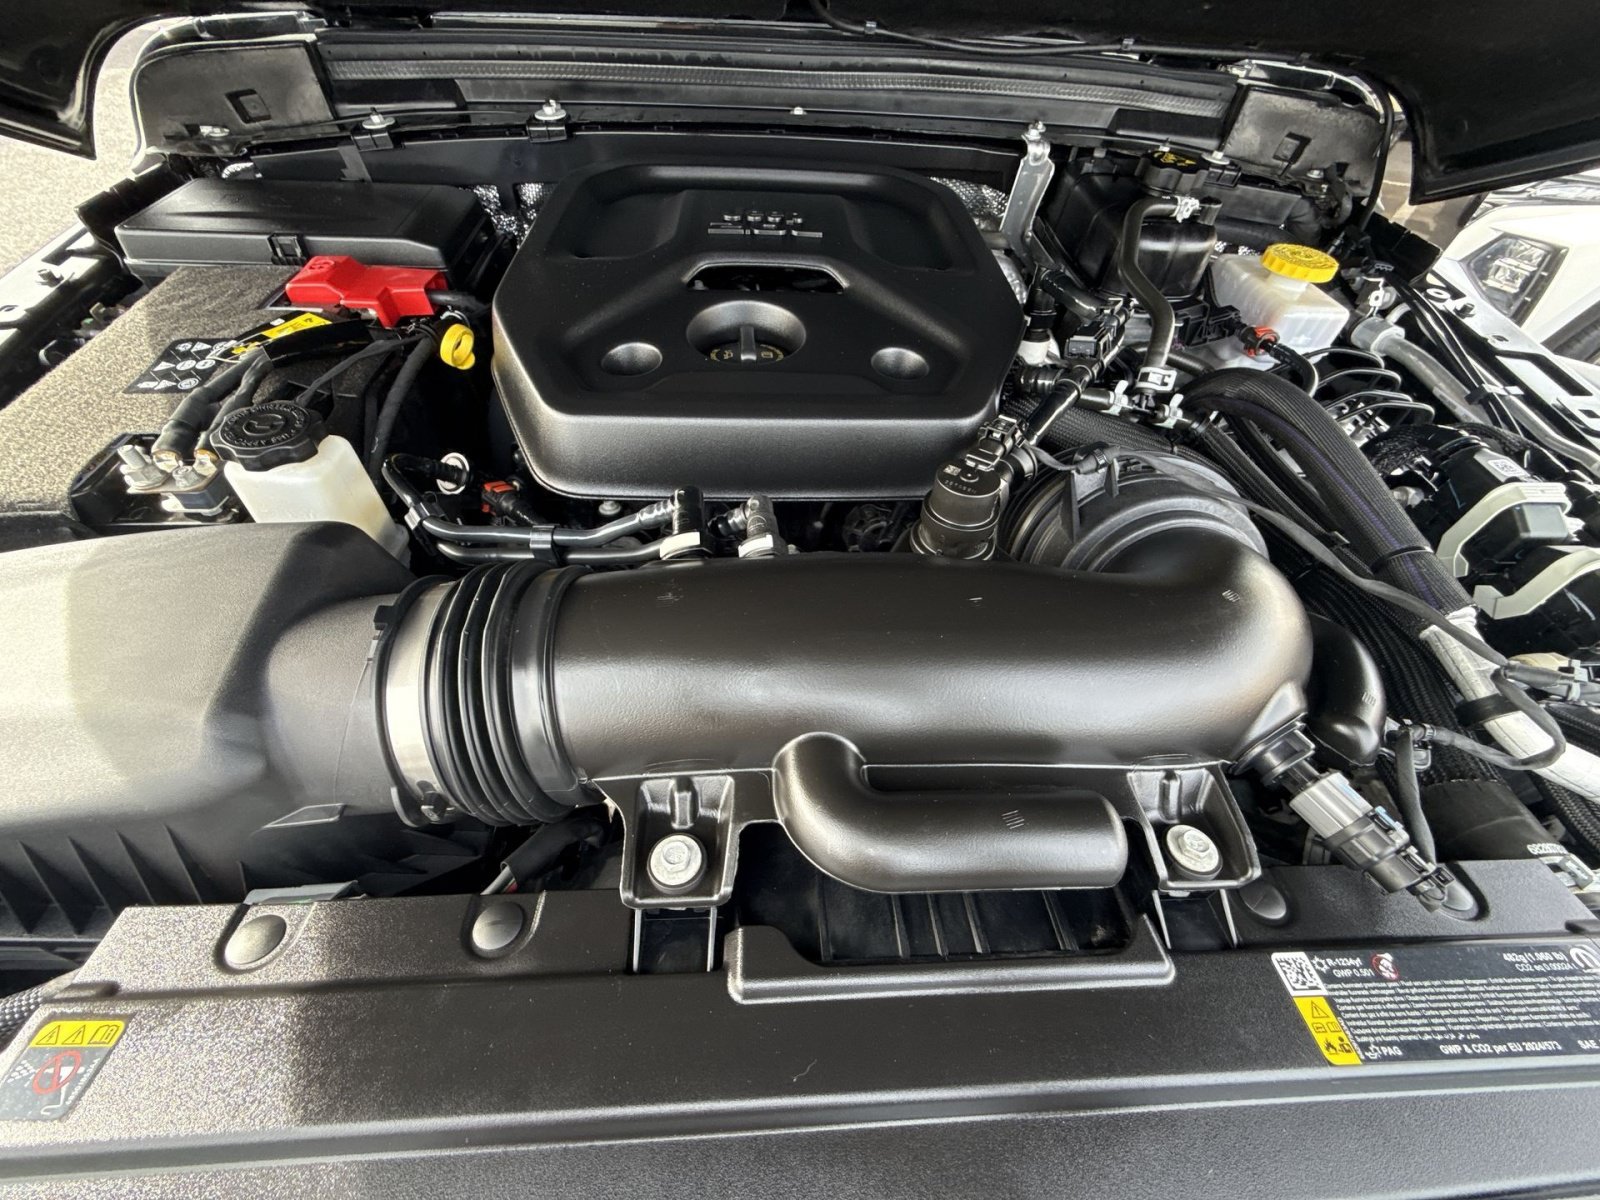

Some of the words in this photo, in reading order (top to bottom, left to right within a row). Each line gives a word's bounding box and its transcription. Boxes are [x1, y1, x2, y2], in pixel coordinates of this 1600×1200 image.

[1332, 969, 1353, 978] GWP
[1439, 1044, 1463, 1055] GWP
[1471, 1043, 1494, 1053] CO2
[1492, 1044, 1510, 1054] per
[1507, 1042, 1524, 1052] EU
[1577, 1039, 1600, 1049] SAE
[1380, 1046, 1403, 1056] PAG
